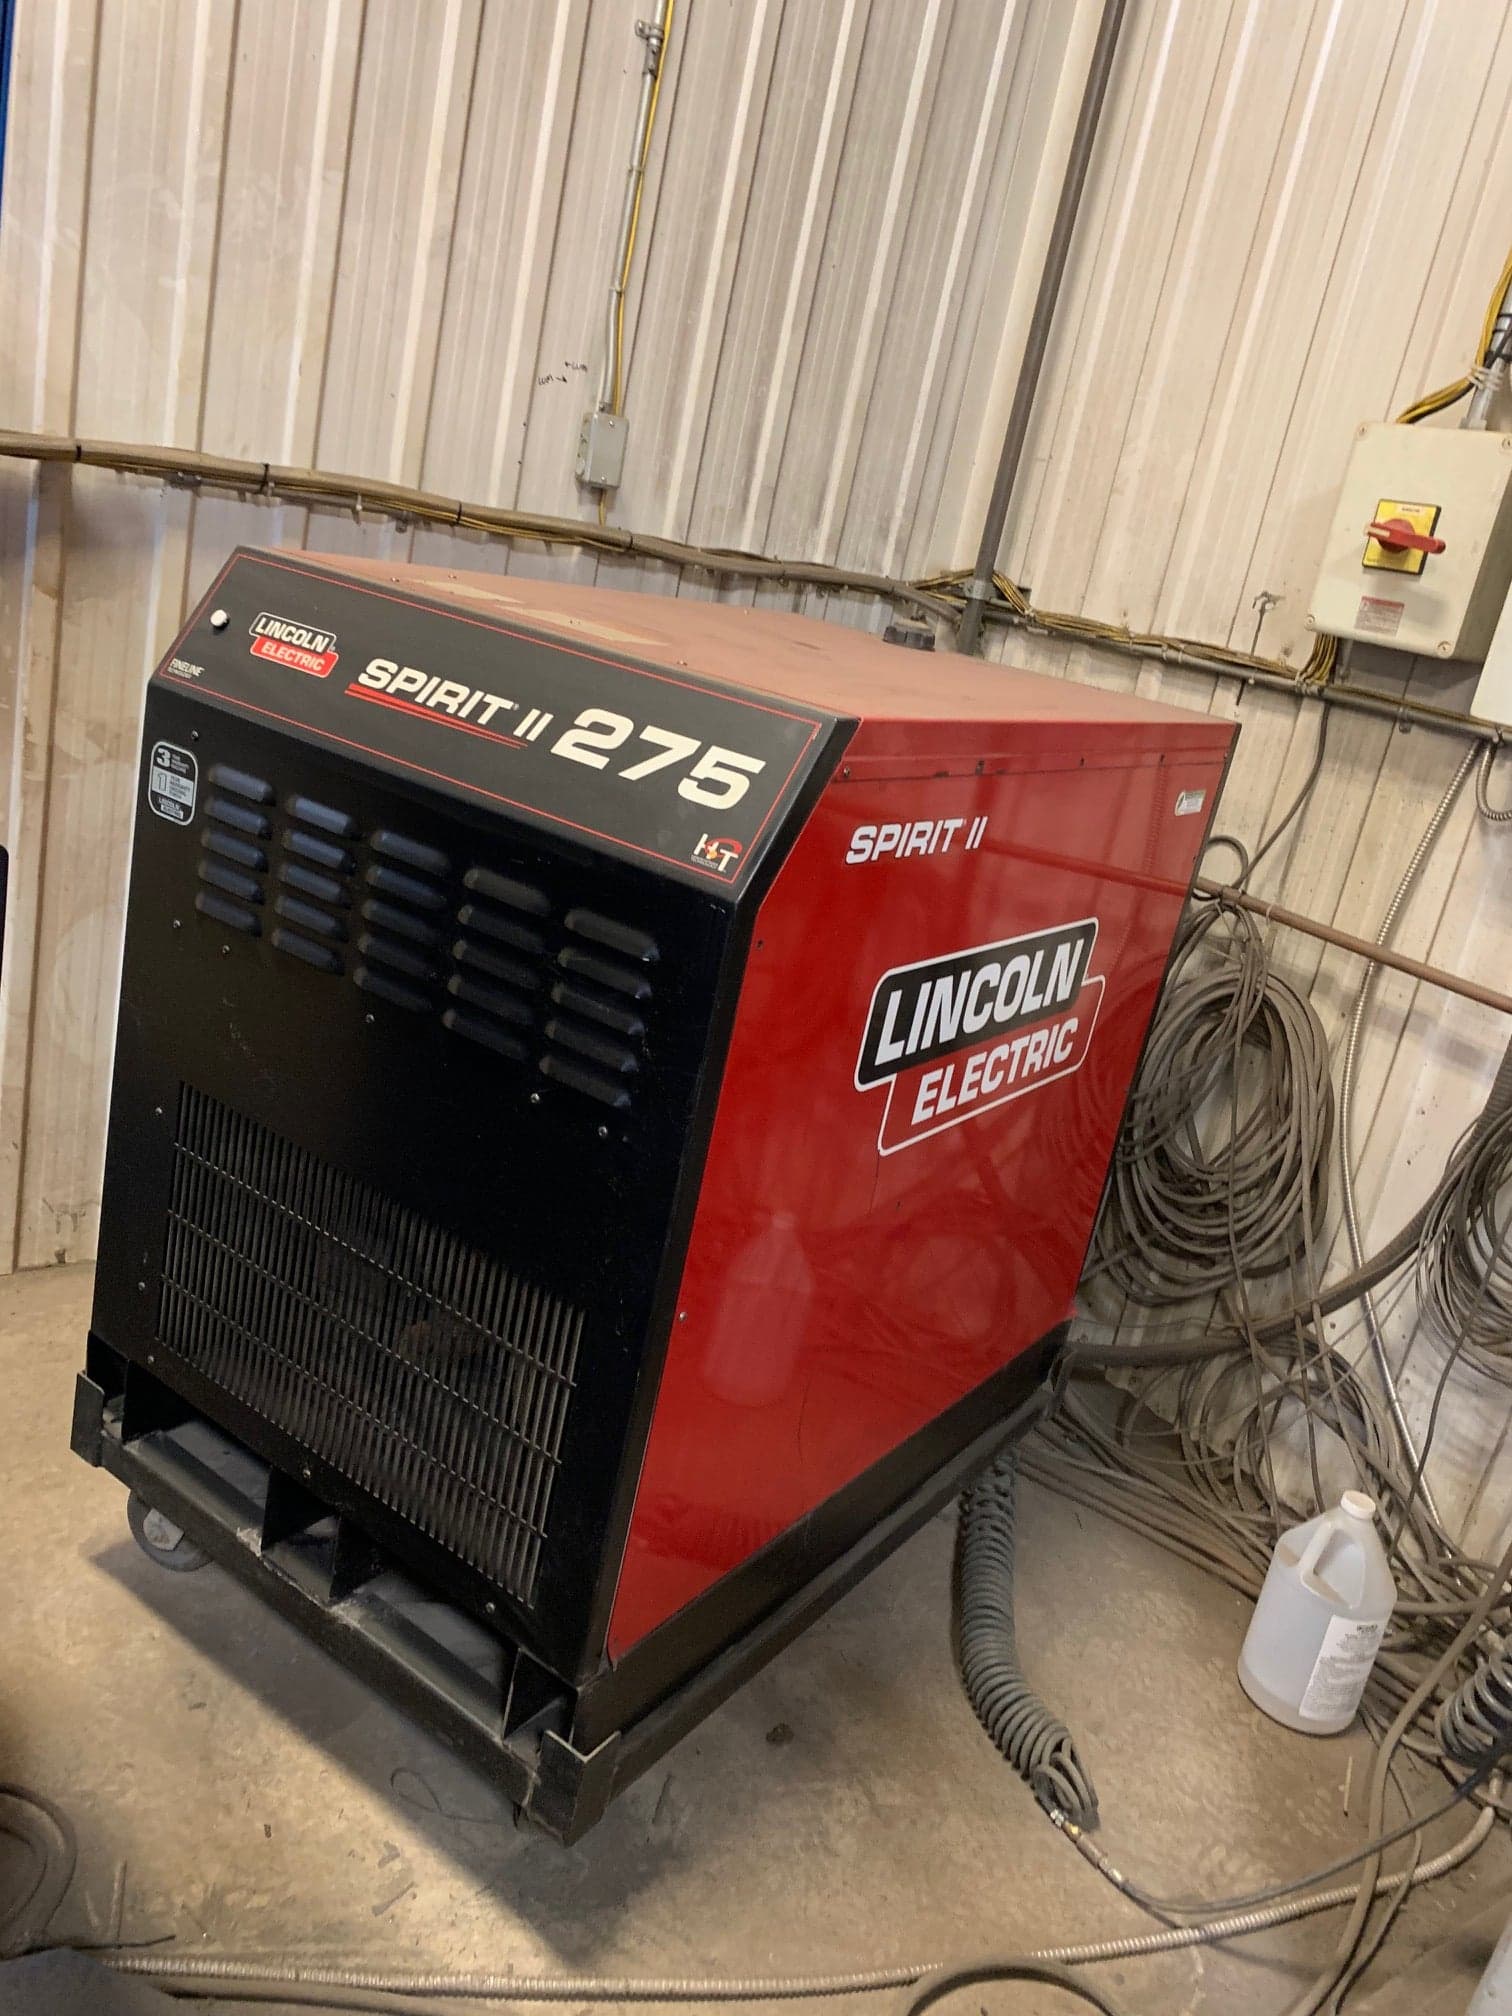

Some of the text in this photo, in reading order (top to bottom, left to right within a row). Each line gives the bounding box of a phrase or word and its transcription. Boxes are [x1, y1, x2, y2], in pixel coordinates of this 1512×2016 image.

[255, 617, 329, 653] LINCOLN
[261, 642, 326, 671] ELECTRIC
[357, 657, 516, 726] SPIRIT
[550, 707, 767, 811] 275
[156, 748, 171, 768] 3
[157, 772, 168, 792] 1
[845, 816, 988, 865] SPIRIT II
[874, 938, 1085, 1066] LINCOLN
[911, 1017, 1079, 1126] ELECTRIC
